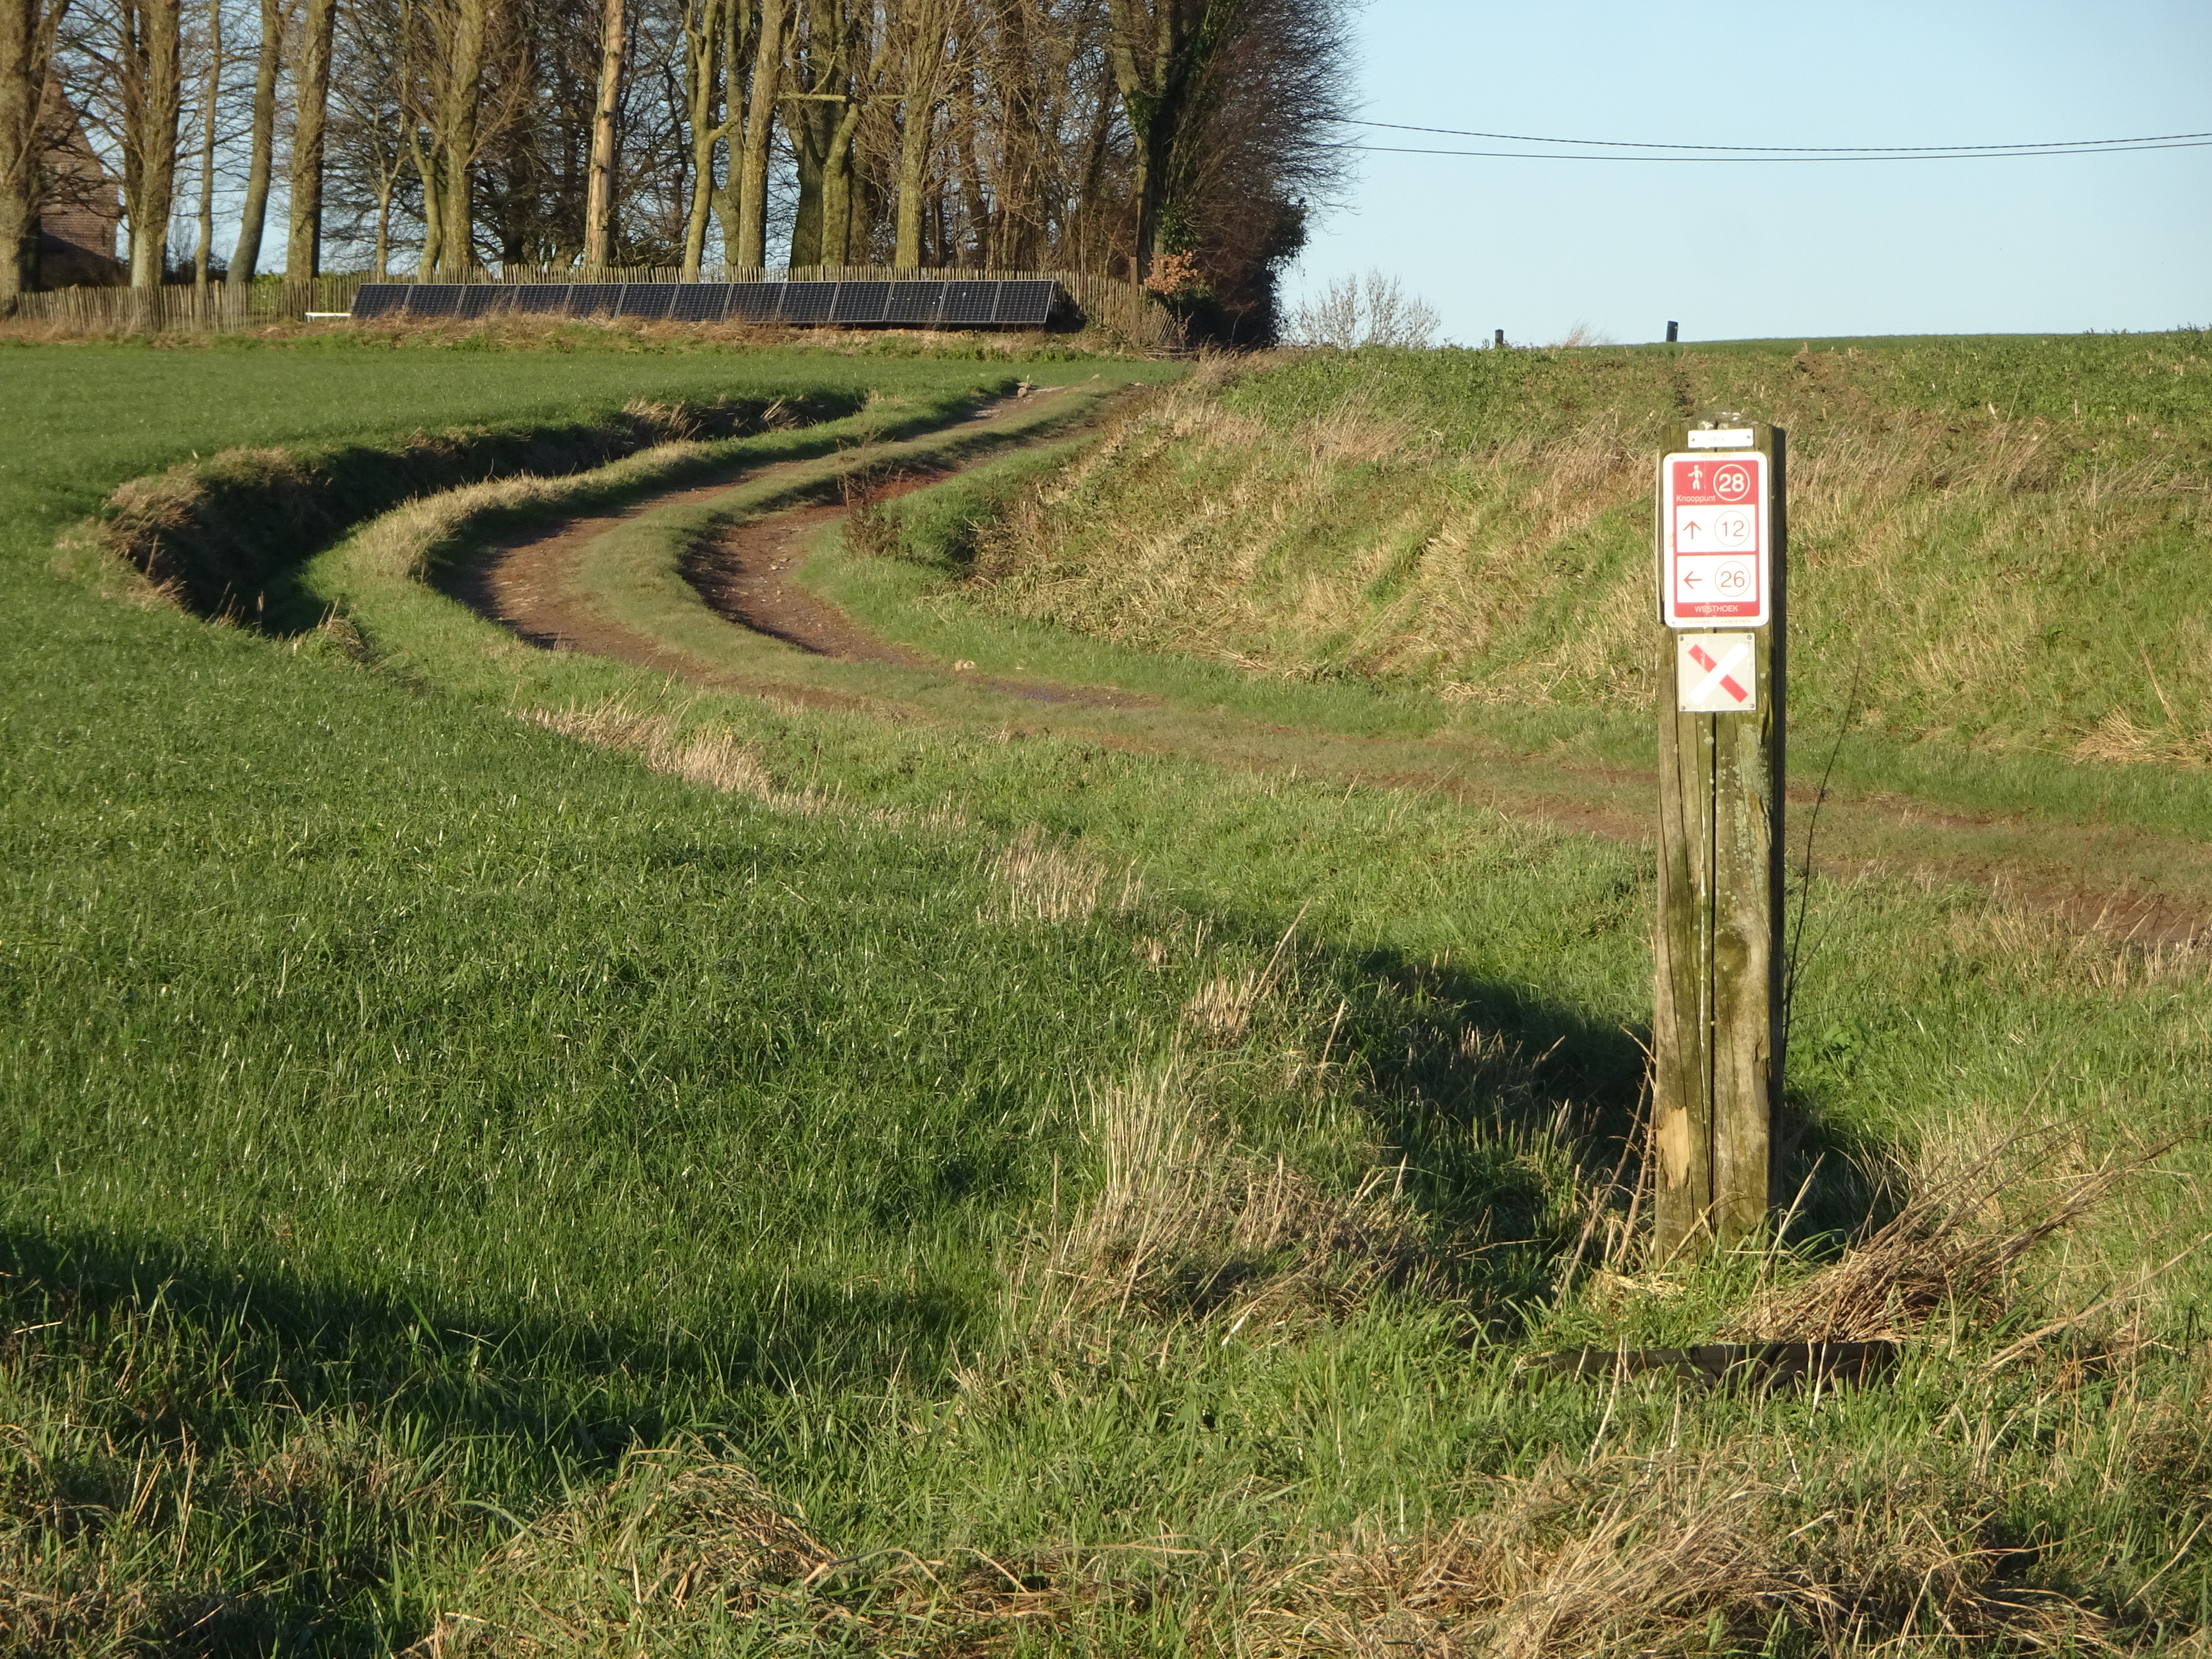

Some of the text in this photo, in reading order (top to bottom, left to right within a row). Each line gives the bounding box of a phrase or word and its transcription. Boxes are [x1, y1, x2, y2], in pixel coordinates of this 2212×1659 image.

[1719, 473, 1744, 492] 28
[1721, 520, 1744, 537] 12
[1721, 571, 1745, 587] 26
